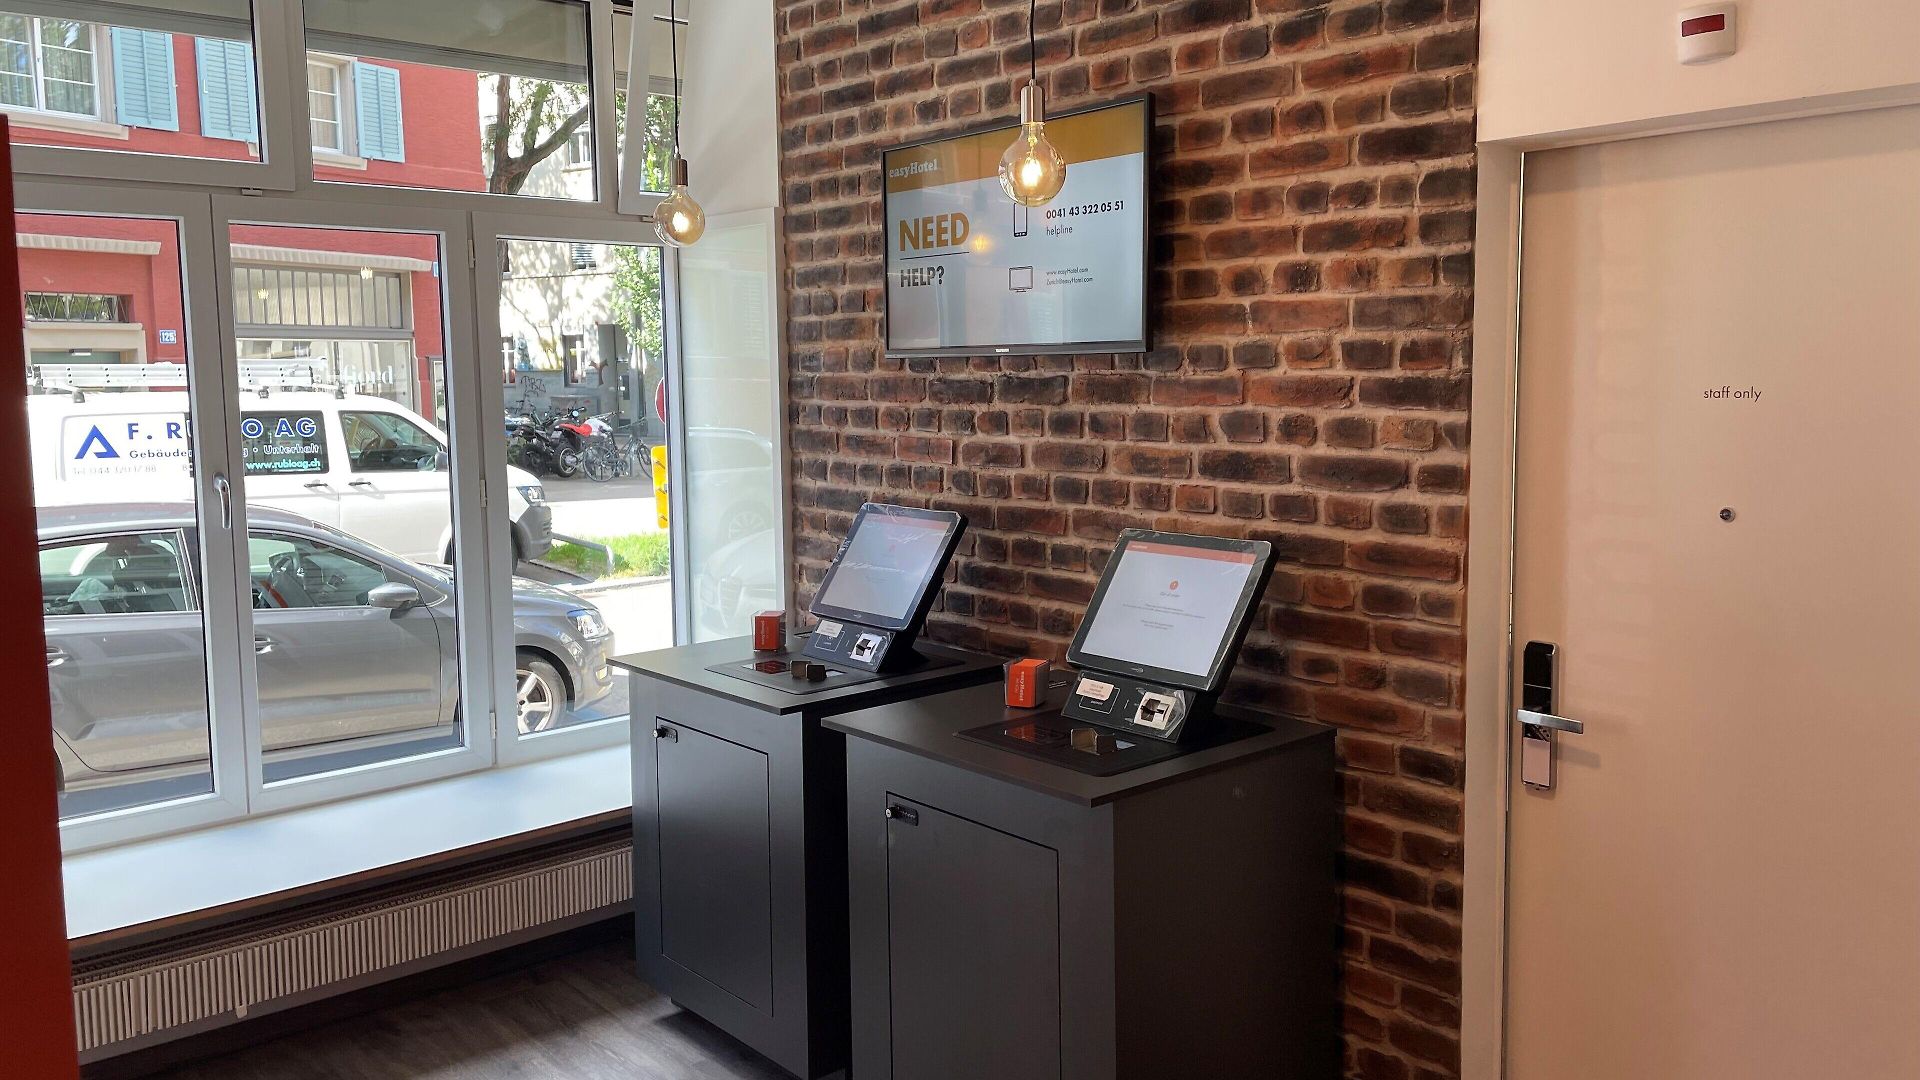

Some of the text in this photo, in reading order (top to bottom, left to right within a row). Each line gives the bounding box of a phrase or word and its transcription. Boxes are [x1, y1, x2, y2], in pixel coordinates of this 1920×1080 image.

[889, 159, 938, 178] easyHotel
[1046, 200, 1124, 219] 0041 43 322 05 51
[899, 212, 970, 252] NEED
[1046, 224, 1073, 237] helpline
[900, 265, 945, 288] HELP?
[161, 331, 176, 342] 125
[1703, 385, 1762, 403] staff only
[127, 422, 152, 440] F.
[274, 417, 317, 438] AG
[263, 442, 320, 456] Unterhalt
[245, 458, 321, 470] www.rubioag.ch
